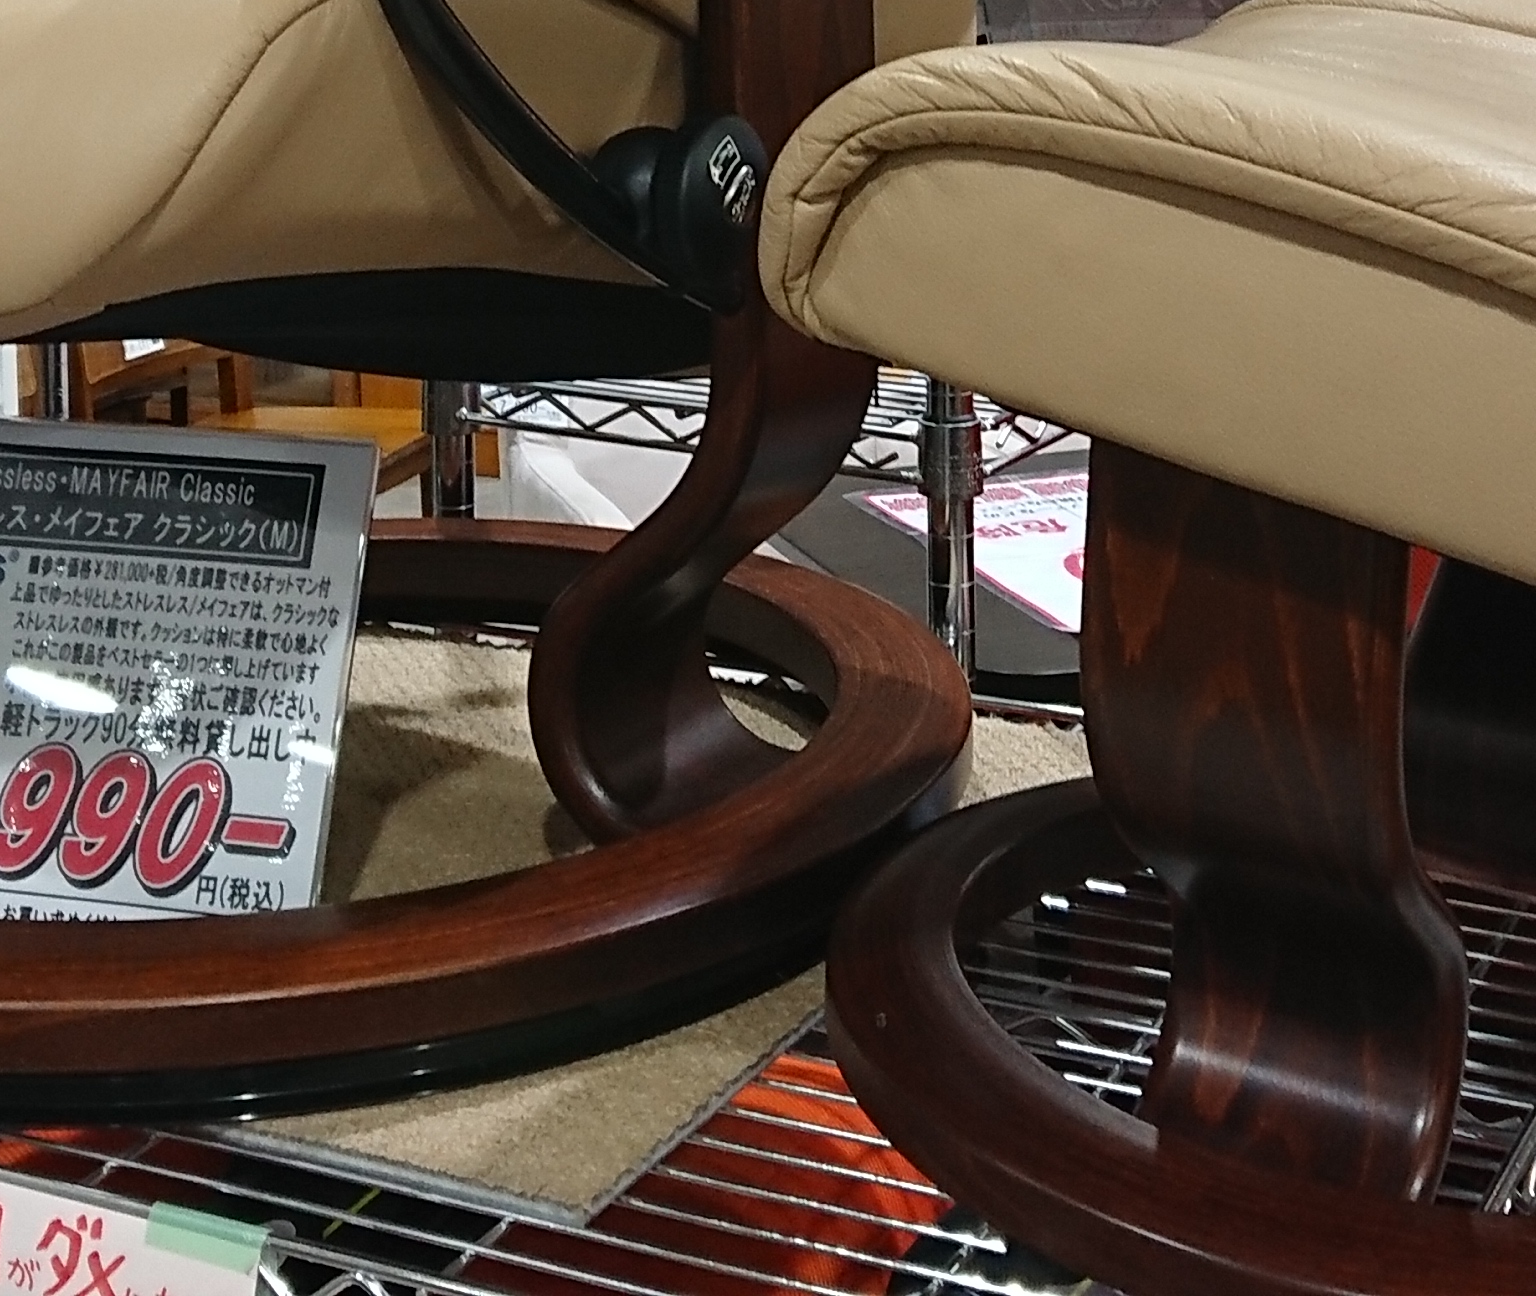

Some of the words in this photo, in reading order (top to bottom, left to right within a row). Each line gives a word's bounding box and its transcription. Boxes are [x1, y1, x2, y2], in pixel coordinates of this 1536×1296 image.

[179, 472, 256, 506] Classic
[153, 512, 299, 553] クラシック(M)
[195, 874, 285, 912] 円(税込)
